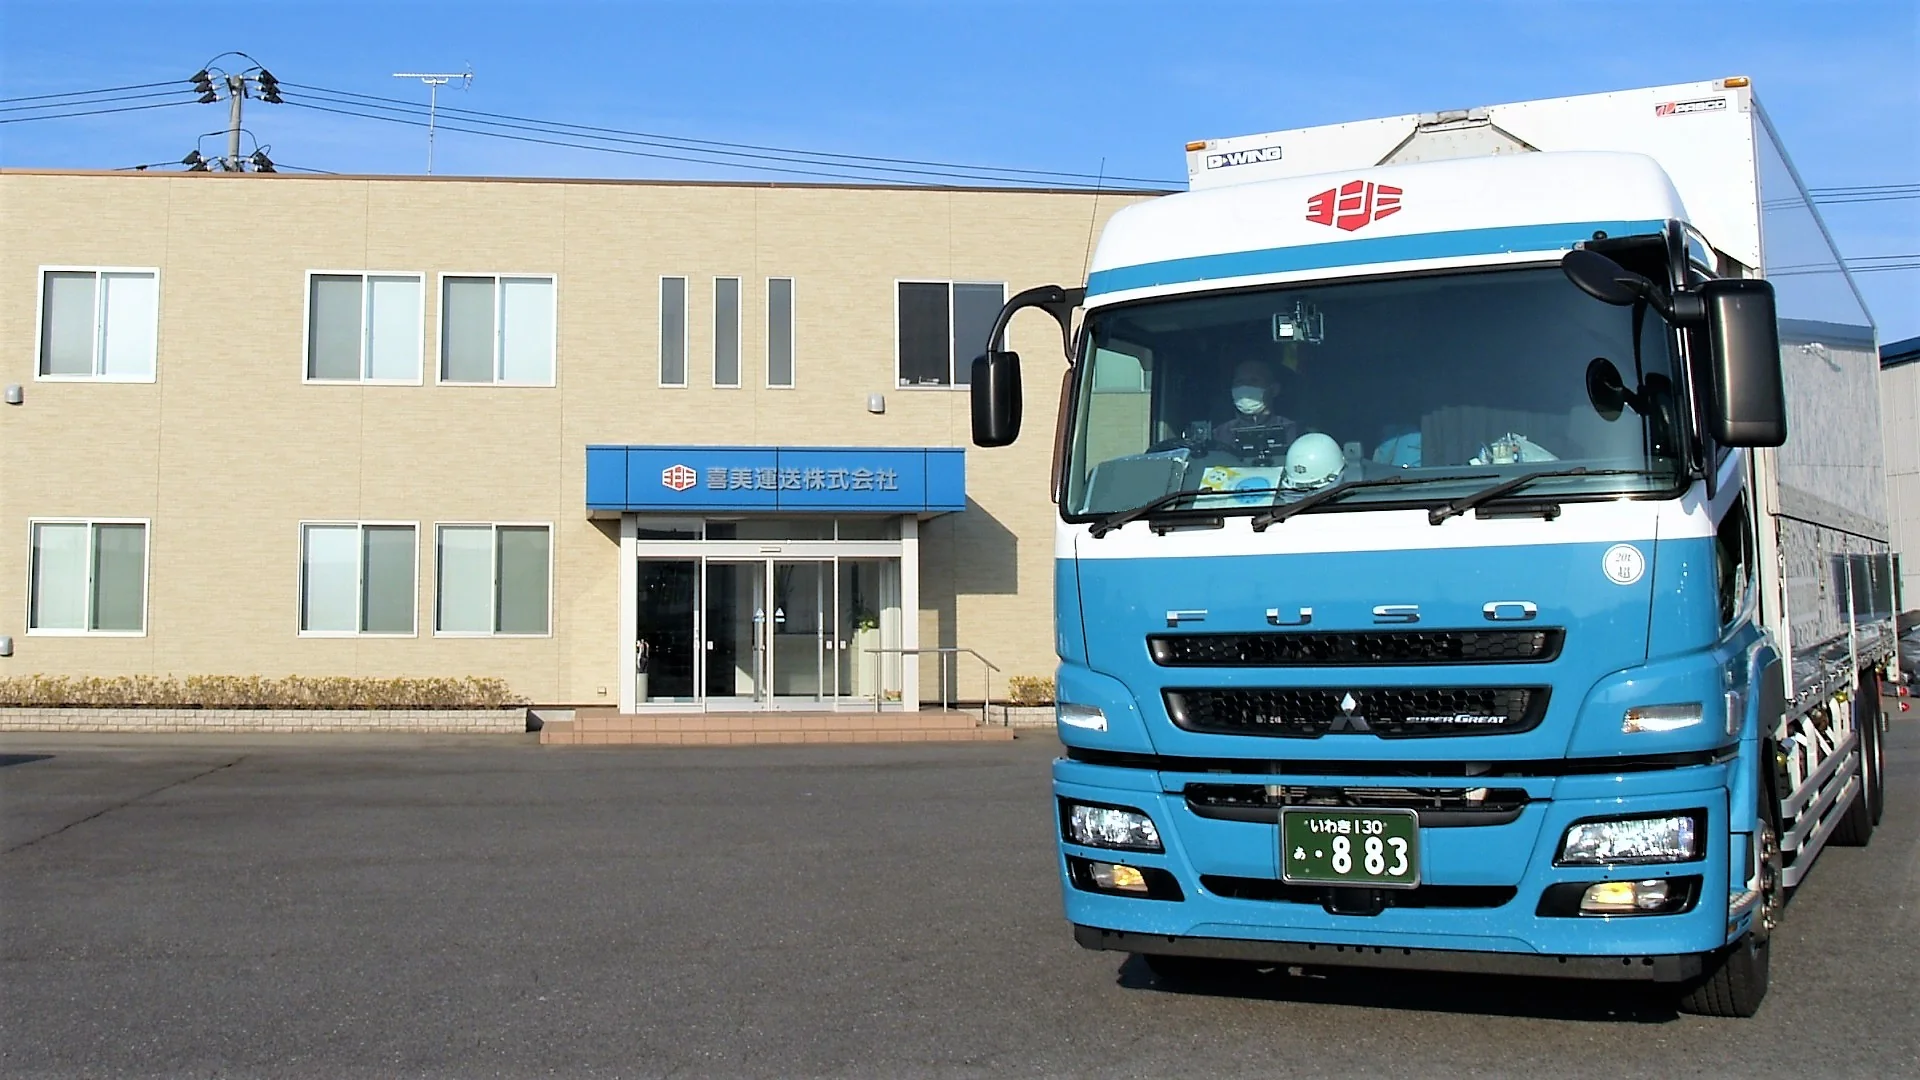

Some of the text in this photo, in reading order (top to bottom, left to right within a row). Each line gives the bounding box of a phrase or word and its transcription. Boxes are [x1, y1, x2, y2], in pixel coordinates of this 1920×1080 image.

[705, 467, 900, 492] 喜美運送株式会社
[1166, 601, 1538, 628] FUSO
[1293, 846, 1307, 860] あ
